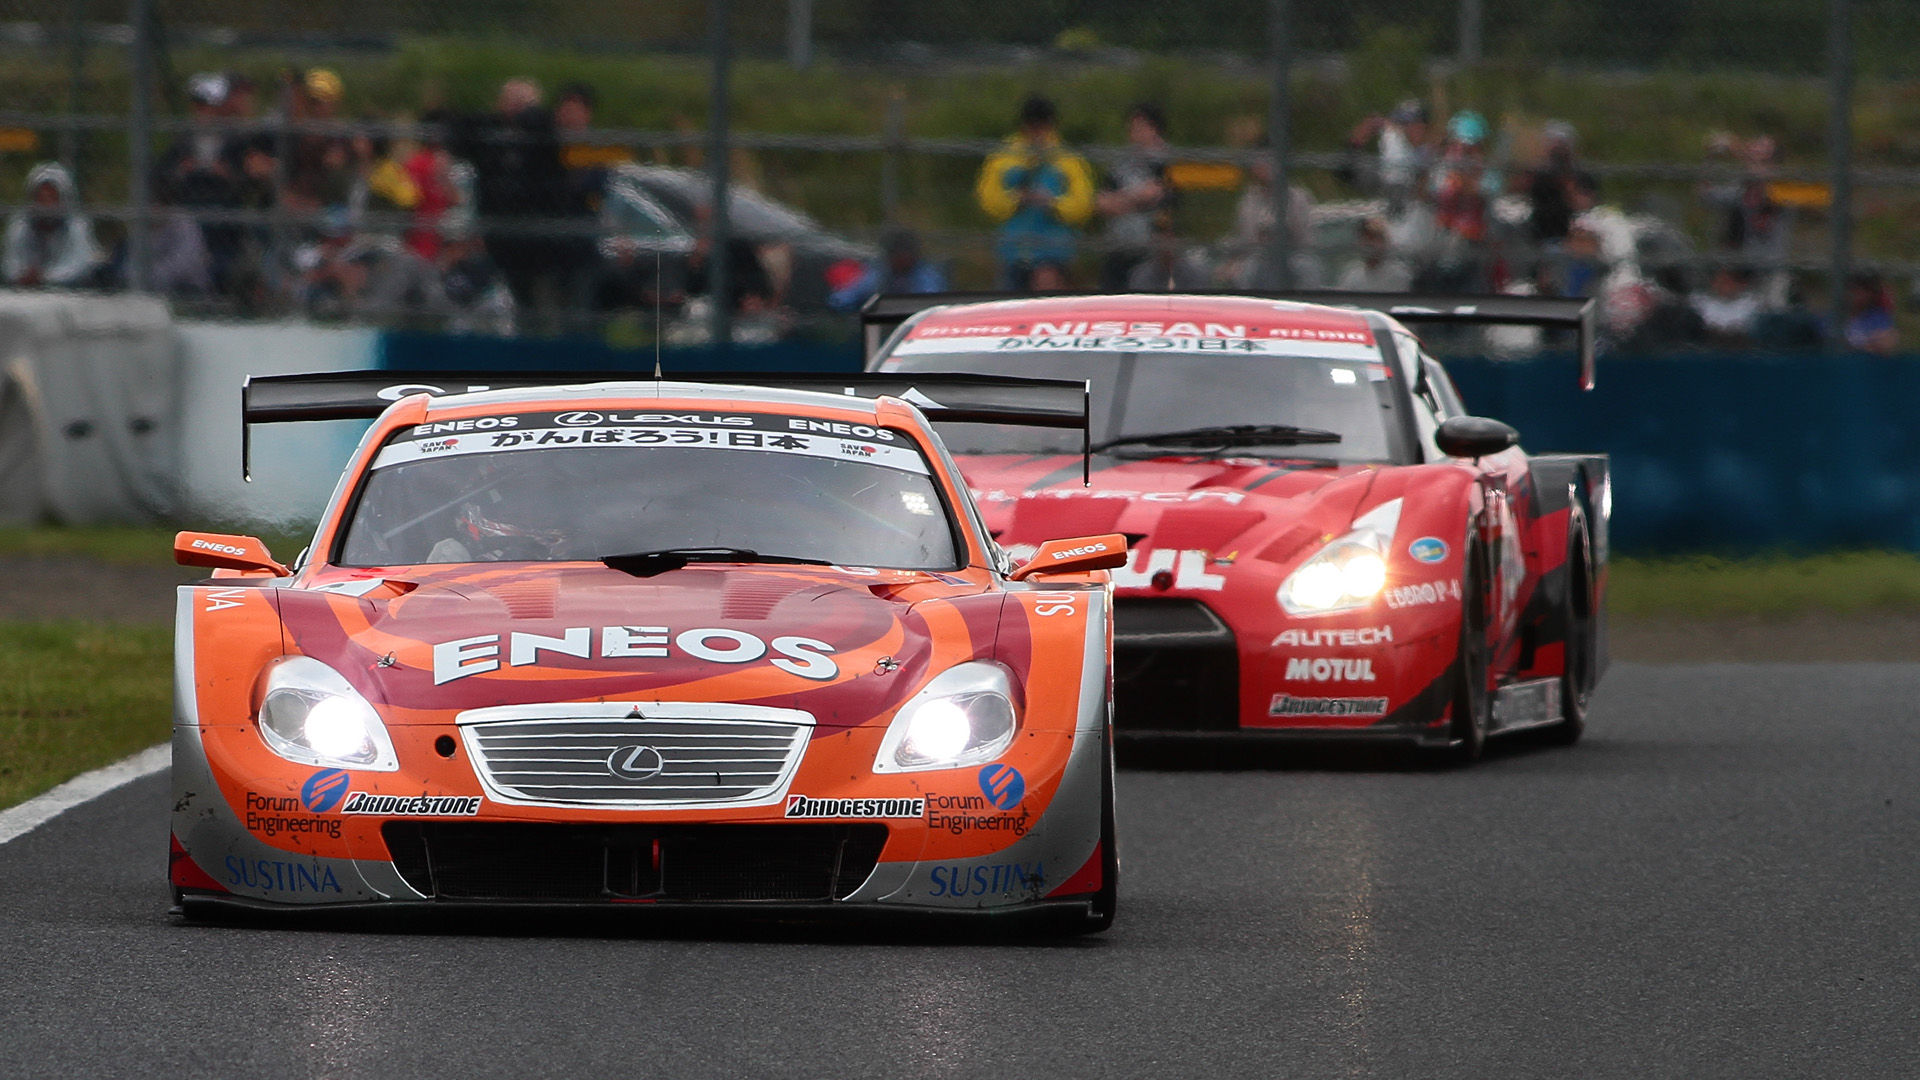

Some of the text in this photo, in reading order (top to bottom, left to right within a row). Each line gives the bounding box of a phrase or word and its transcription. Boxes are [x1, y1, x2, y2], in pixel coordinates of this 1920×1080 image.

[1029, 321, 1247, 339] NISSAN
[413, 414, 895, 441] ENEOS LEXUS ENEOS
[490, 428, 811, 450] がんばろう!日本
[841, 449, 872, 457] JAPAN
[191, 539, 247, 556] ENEOS
[1051, 542, 1108, 560] ENEOS
[1271, 624, 1394, 647] AUTECH
[433, 626, 840, 686] ENEOS
[1284, 657, 1377, 682] MOTUL
[246, 792, 299, 812] Forum
[345, 792, 479, 815] BRIDGESTONE
[788, 796, 924, 818] BRIDGESTONE
[926, 793, 984, 811] Forum
[246, 811, 342, 839] Engineering
[928, 811, 1026, 836] Engineering
[225, 855, 342, 894] SUSTINA
[929, 861, 1046, 897] SUSTINA
